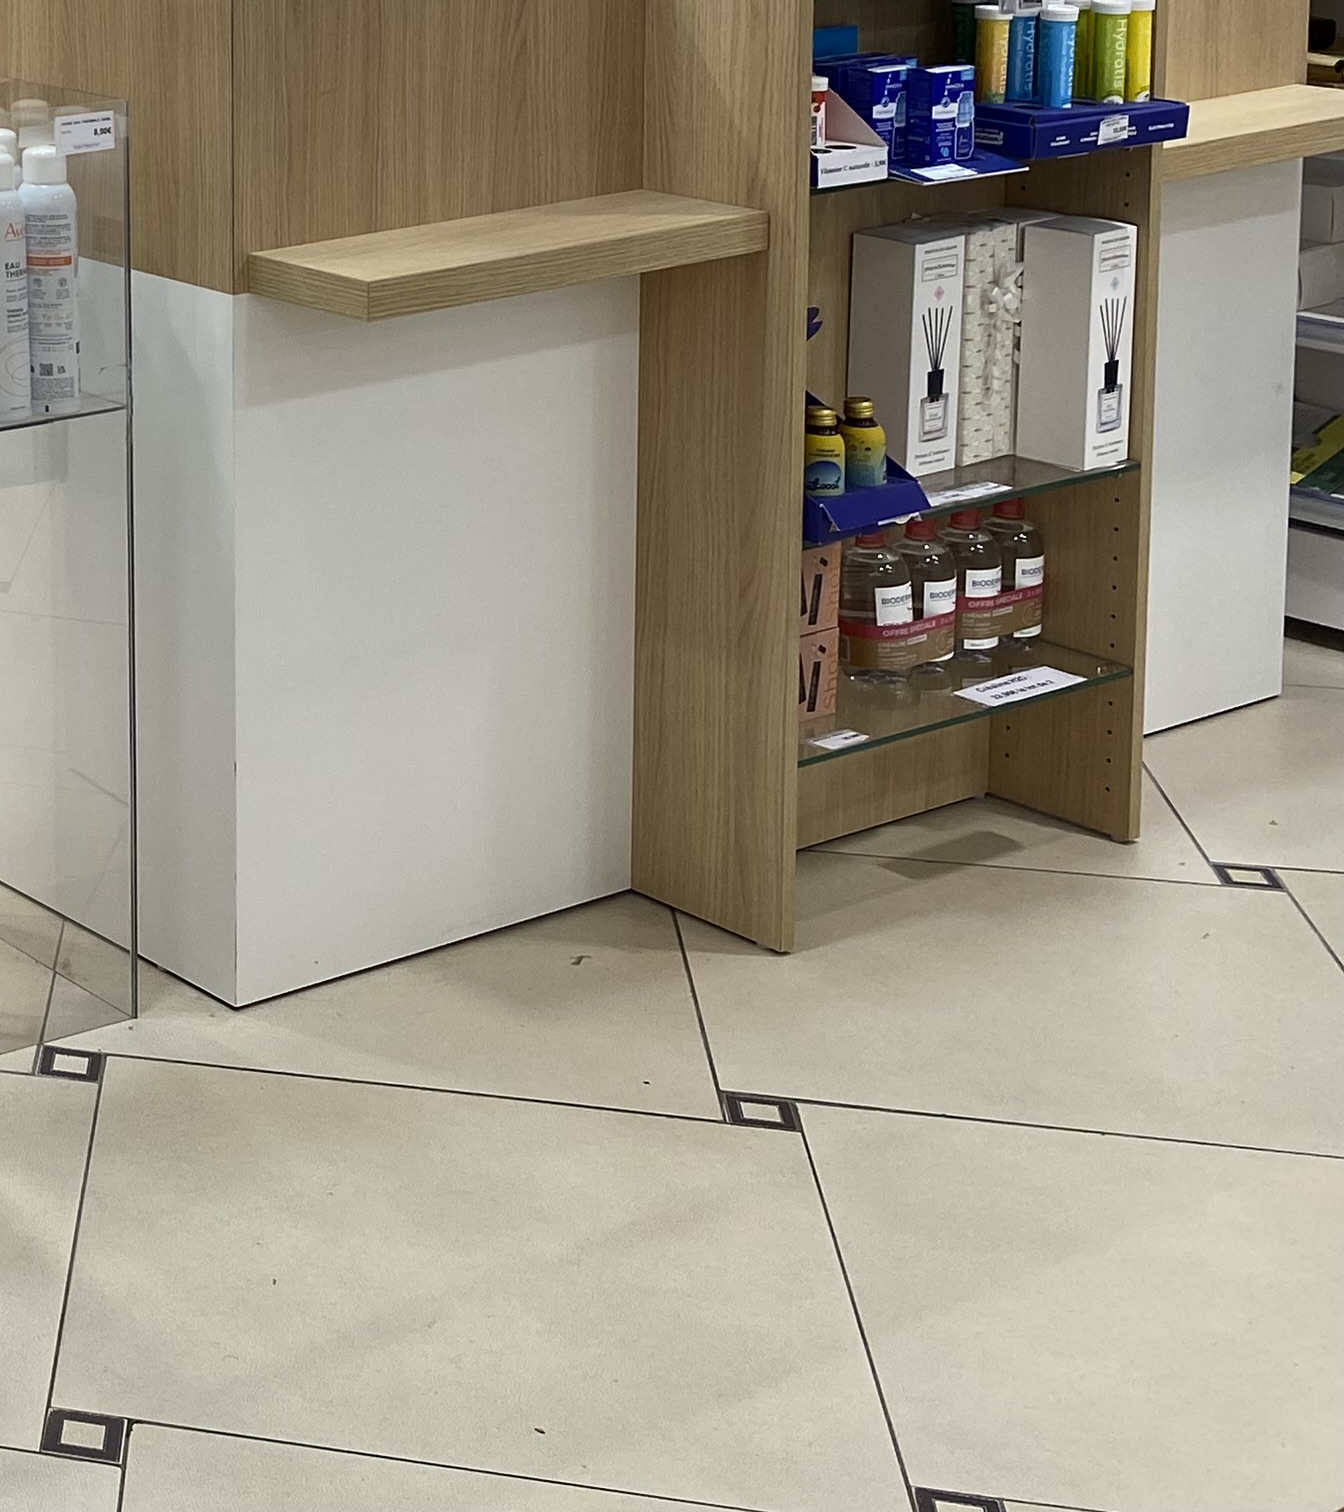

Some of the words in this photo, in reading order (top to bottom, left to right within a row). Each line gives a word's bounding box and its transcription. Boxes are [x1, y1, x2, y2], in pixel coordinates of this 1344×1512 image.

[1116, 19, 1127, 90] Hydratis
[94, 126, 112, 137] 8,90€
[5, 261, 21, 270] EAU
